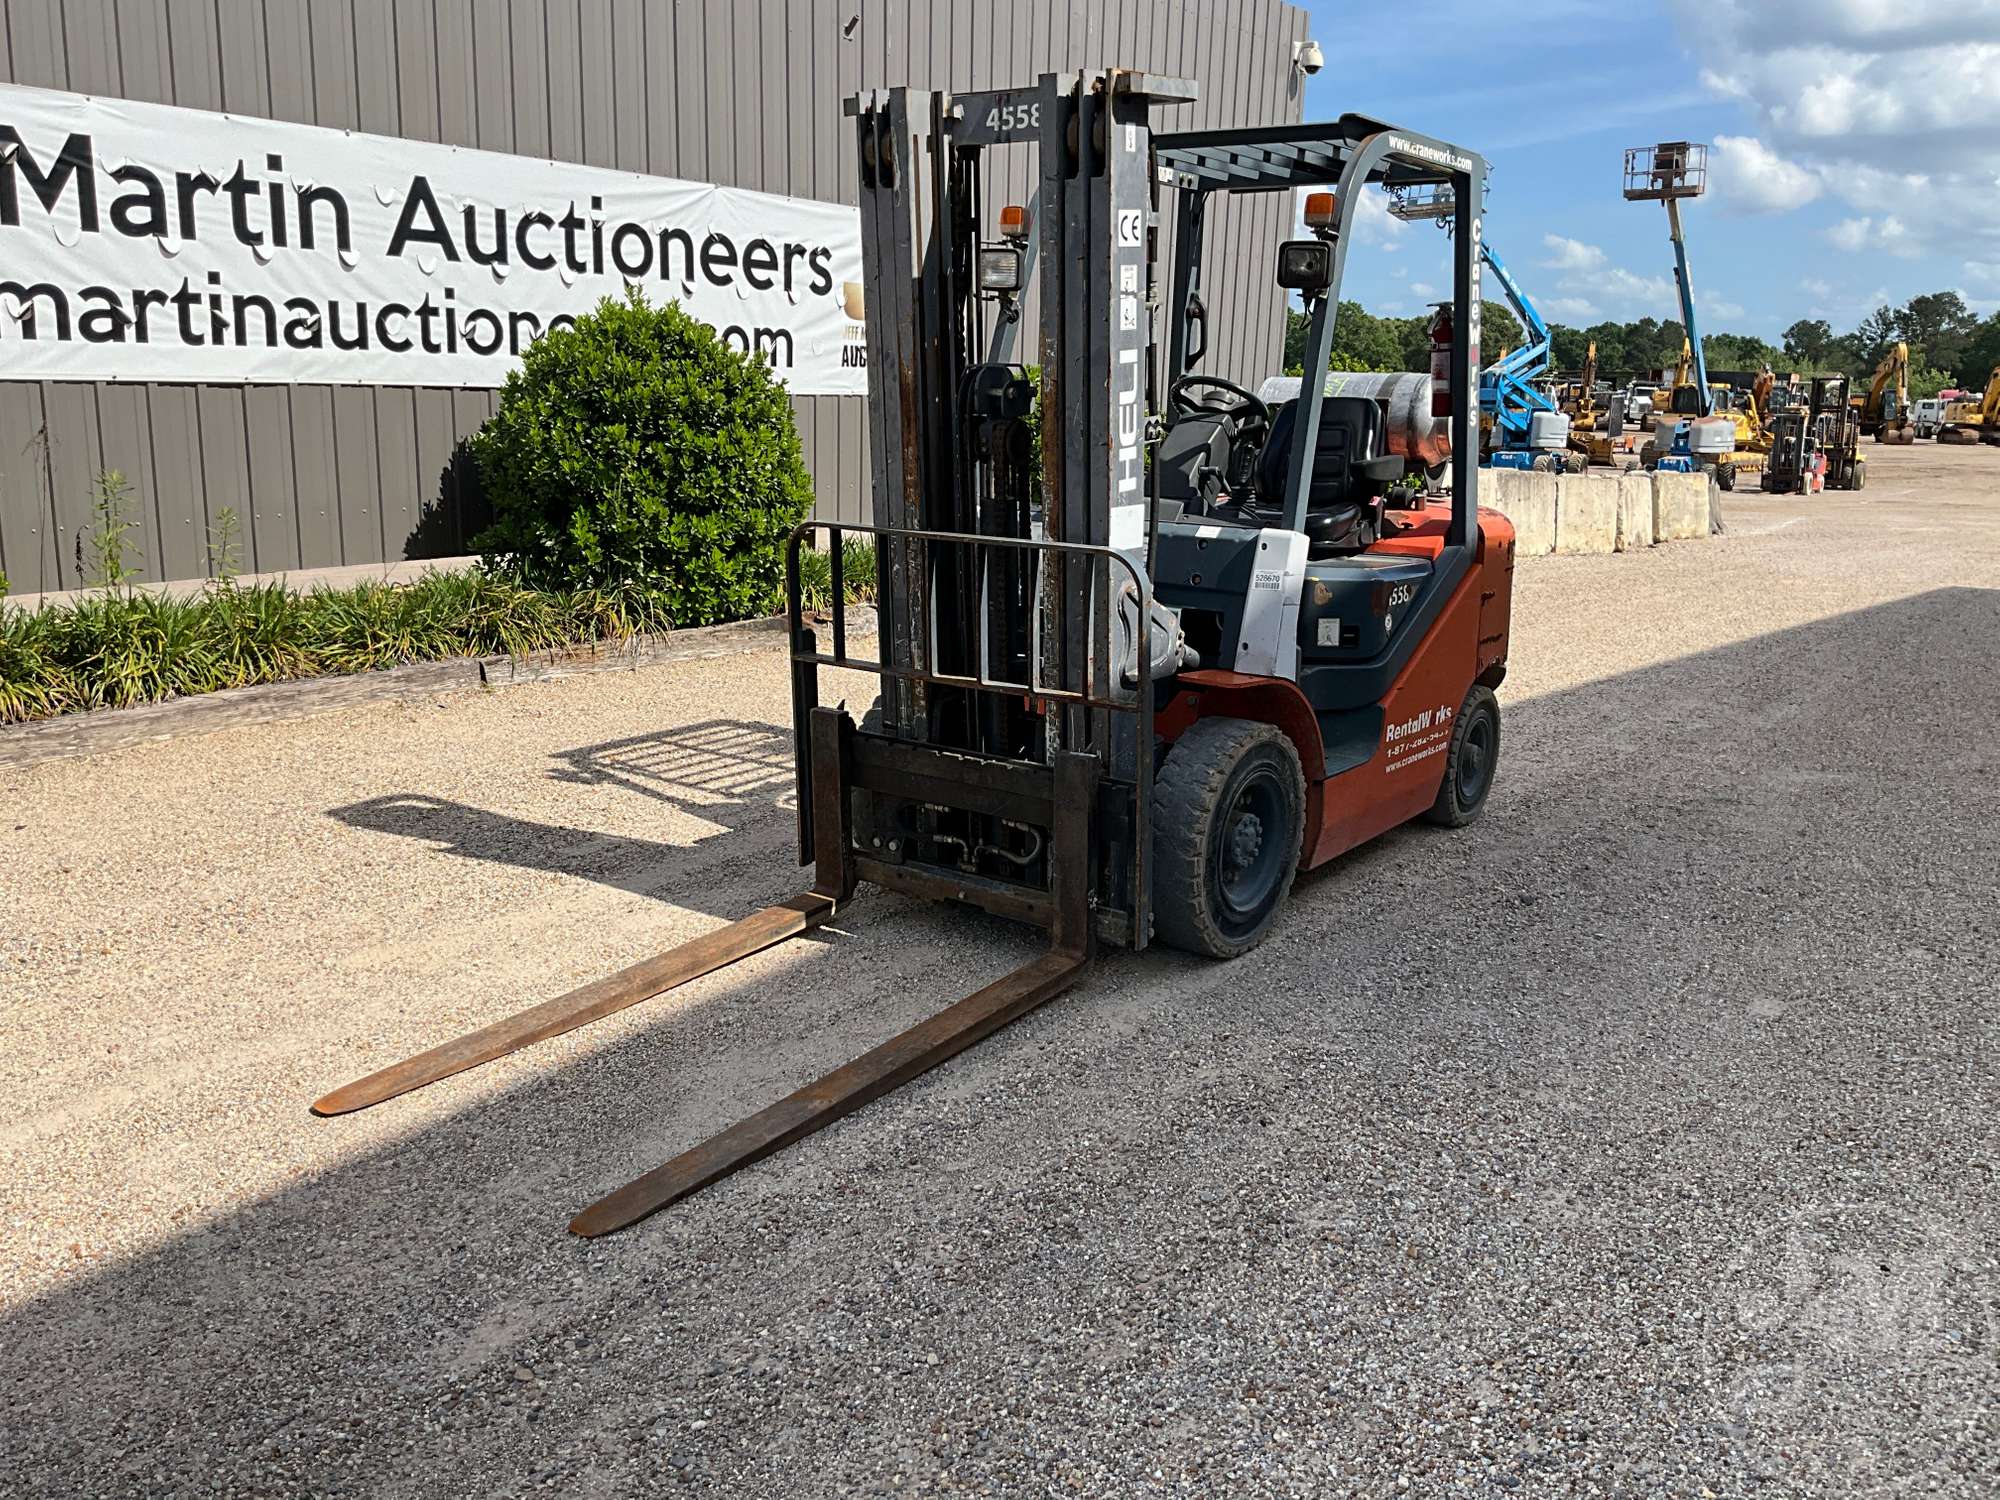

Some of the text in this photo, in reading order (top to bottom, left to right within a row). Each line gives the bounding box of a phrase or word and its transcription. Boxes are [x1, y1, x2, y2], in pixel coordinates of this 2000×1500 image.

[1388, 135, 1472, 170] www.craneworks.com
[0, 124, 833, 296] Martin Auctioneers
[1120, 215, 1140, 241] CE
[1118, 349, 1138, 493] HELI
[1386, 705, 1452, 742] RentalWrks
